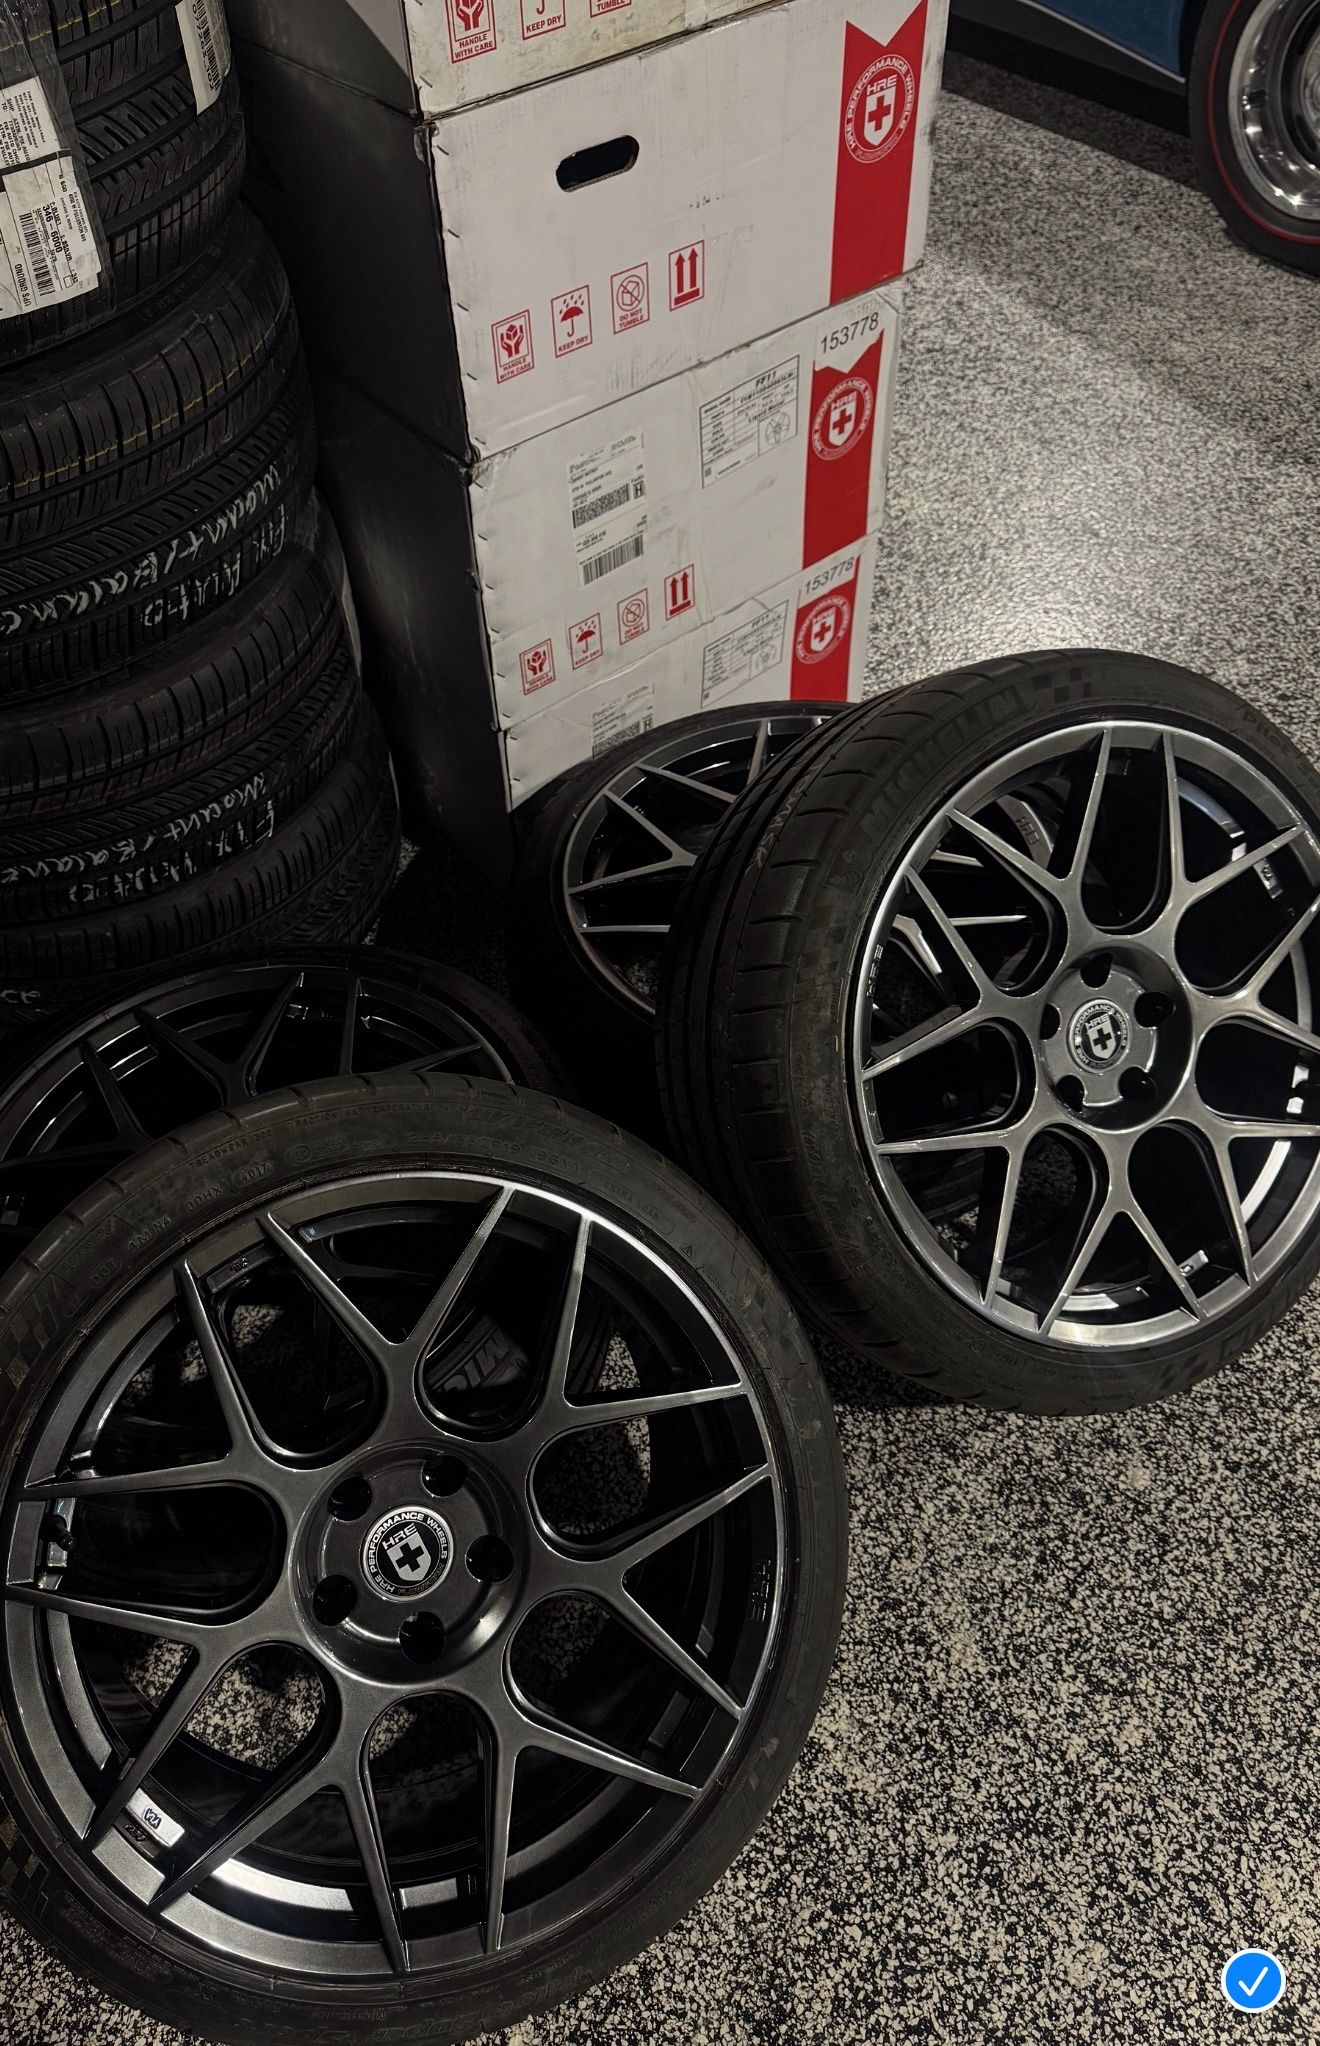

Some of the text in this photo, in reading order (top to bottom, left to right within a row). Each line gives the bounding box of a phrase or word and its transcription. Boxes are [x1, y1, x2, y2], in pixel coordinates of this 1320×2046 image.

[526, 16, 562, 33] KEEP DRY
[459, 33, 487, 48] HANDLE
[455, 41, 493, 59] WITH CARE
[867, 75, 898, 95] HRE
[6, 98, 15, 112] SHIP
[6, 132, 15, 148] AUTO
[22, 146, 30, 161] AUTO
[12, 263, 32, 307] UPS GROUND
[619, 308, 643, 322] DO NOT
[619, 316, 643, 329] TUMBLE
[821, 312, 879, 354] 153778
[558, 335, 588, 352] KEEP DRY
[499, 362, 531, 380] WITH CARE
[503, 358, 526, 372] HANDLE
[805, 556, 854, 594] 153778
[1075, 1005, 1115, 1046] PERFORMANCE
[1116, 1012, 1128, 1046] WHEELS
[1085, 1013, 1110, 1029] HRE
[288, 1111, 337, 1129] TRACTION
[368, 1512, 425, 1573] PERFORMANCE
[381, 1522, 417, 1550] HRE
[426, 1517, 448, 1559] WHEELS
[374, 1575, 395, 1592] HRE
